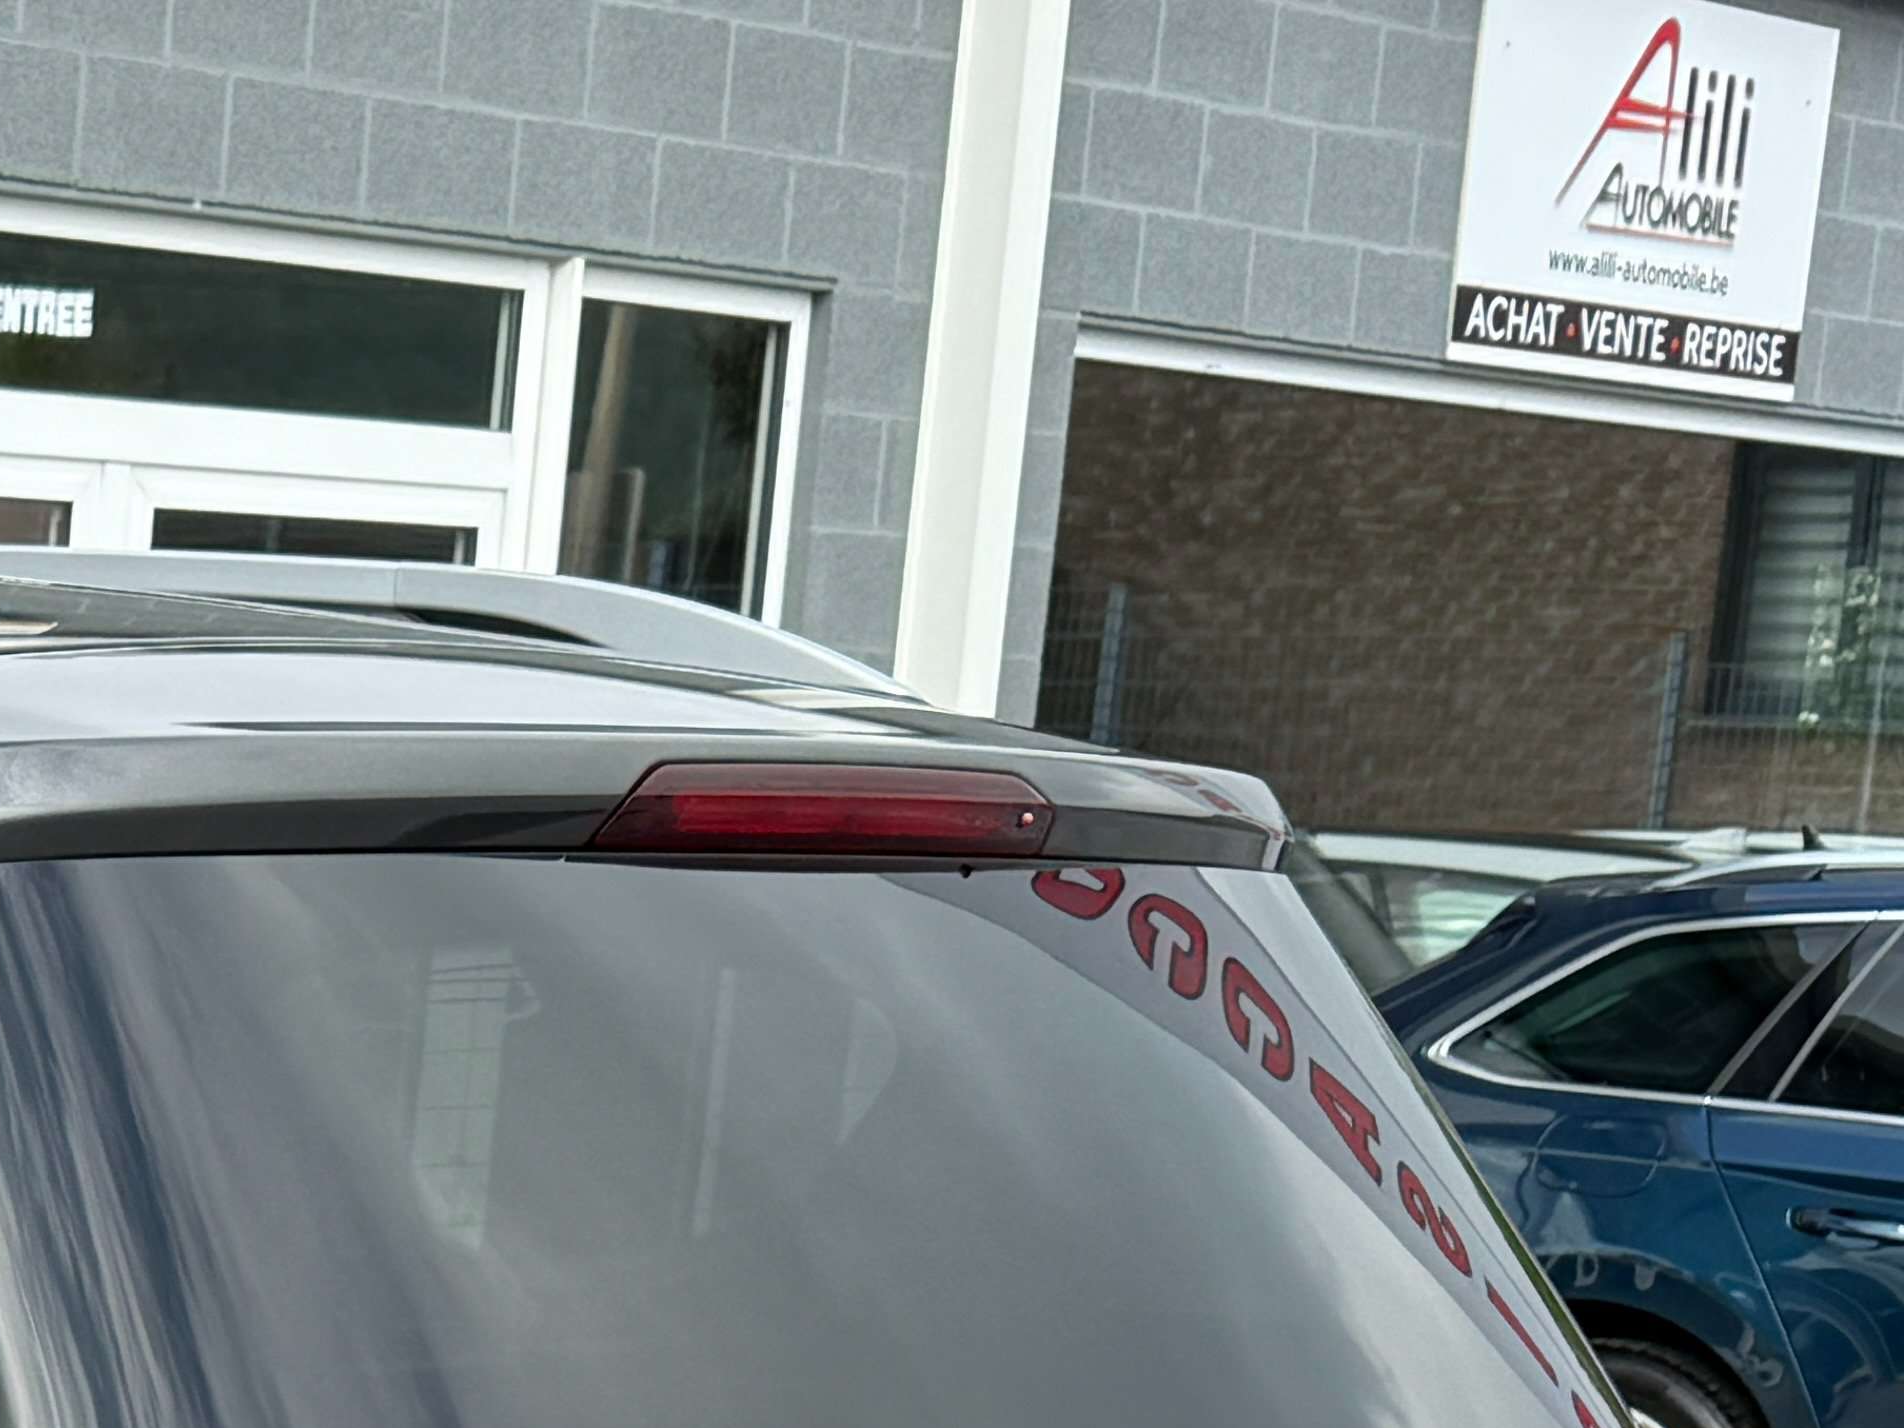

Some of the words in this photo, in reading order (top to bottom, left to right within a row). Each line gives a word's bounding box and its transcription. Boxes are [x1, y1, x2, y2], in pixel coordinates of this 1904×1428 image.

[1555, 16, 1755, 208] Alili
[1548, 248, 1729, 297] www.alili-automobile.be
[1464, 293, 1565, 348] ACHAT
[1579, 307, 1668, 362] VENTE
[1682, 322, 1786, 377] REPRISE
